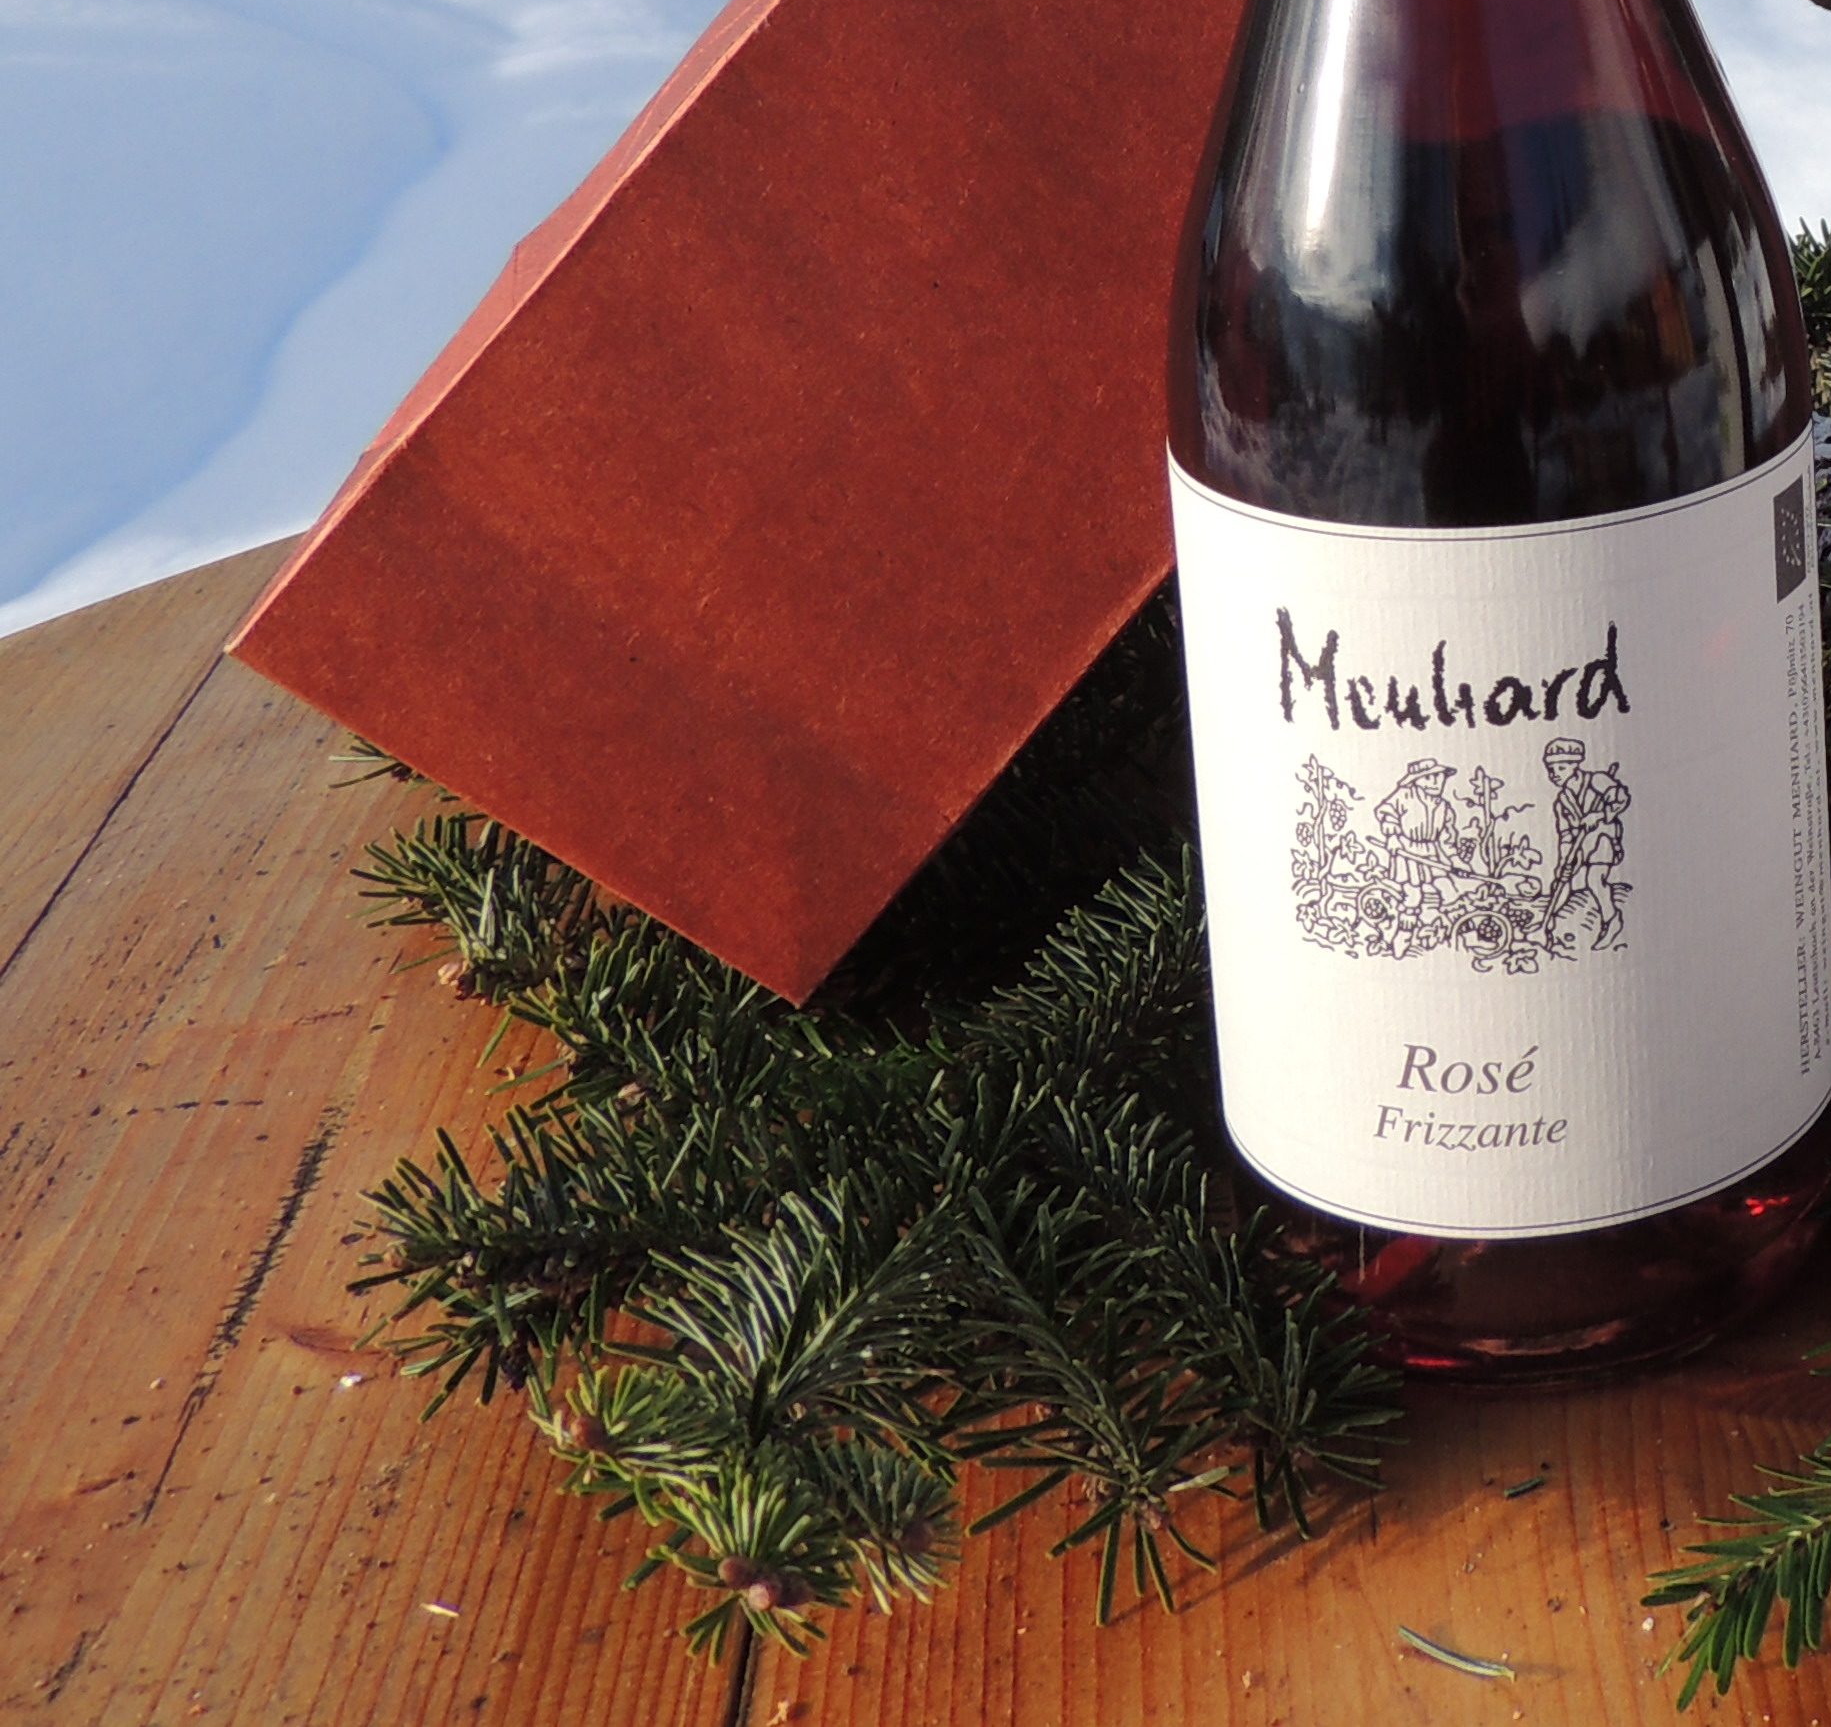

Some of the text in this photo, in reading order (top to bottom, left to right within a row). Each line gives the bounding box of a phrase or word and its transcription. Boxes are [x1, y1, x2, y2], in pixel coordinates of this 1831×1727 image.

[1785, 614, 1795, 635] 70
[1792, 828, 1805, 930] WEINGUT
[1396, 1043, 1539, 1095] Rosé
[1373, 1104, 1569, 1153] Frizzante
